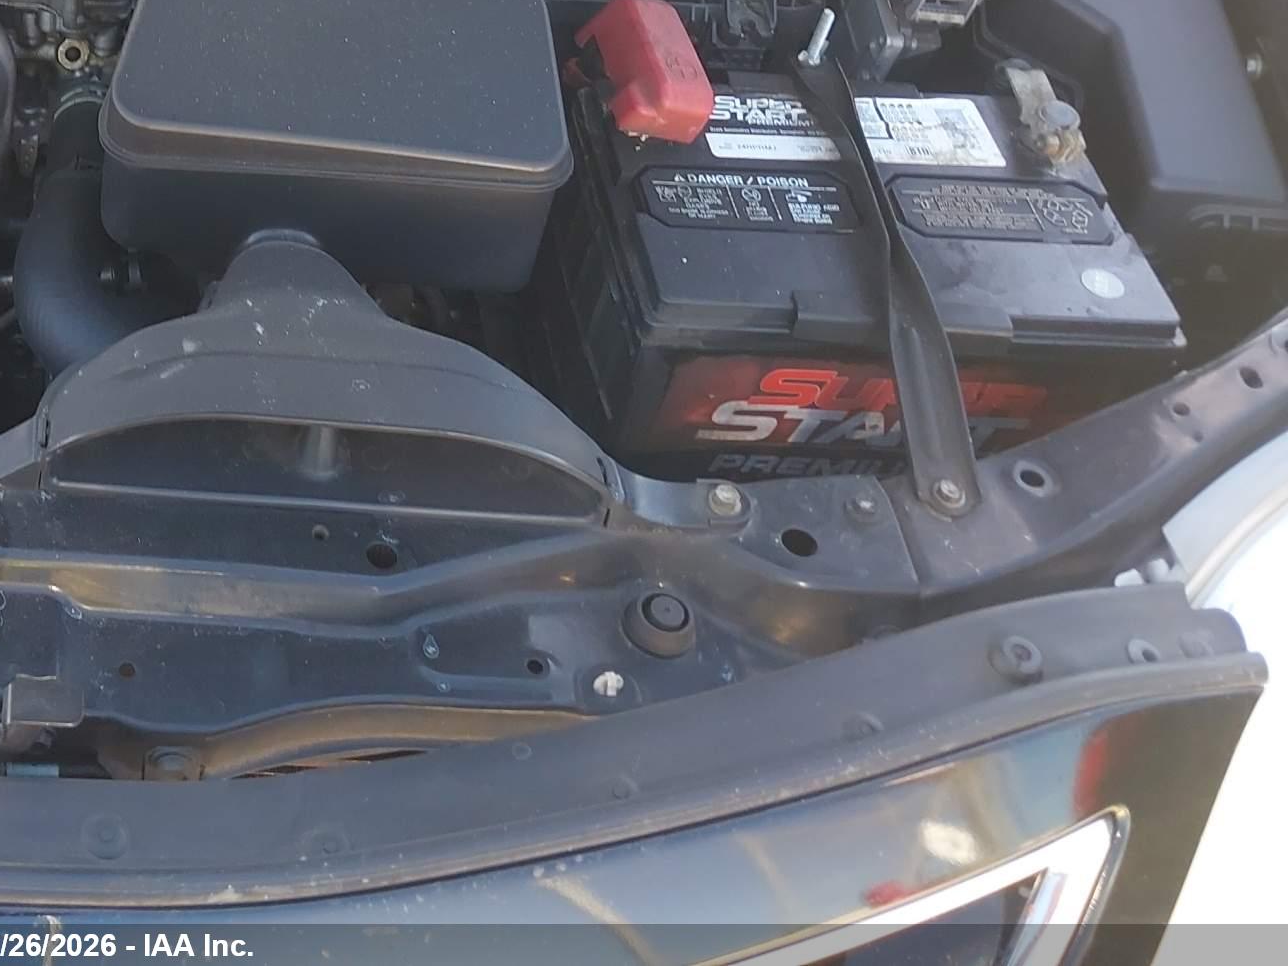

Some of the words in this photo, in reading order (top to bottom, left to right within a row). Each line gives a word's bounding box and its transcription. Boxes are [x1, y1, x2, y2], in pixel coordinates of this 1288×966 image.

[713, 95, 803, 112] SUPER
[708, 107, 807, 122] START
[747, 117, 810, 128] PREMIUM
[687, 173, 744, 186] DANGER
[756, 176, 809, 188] POISON
[695, 400, 1032, 446] STAT
